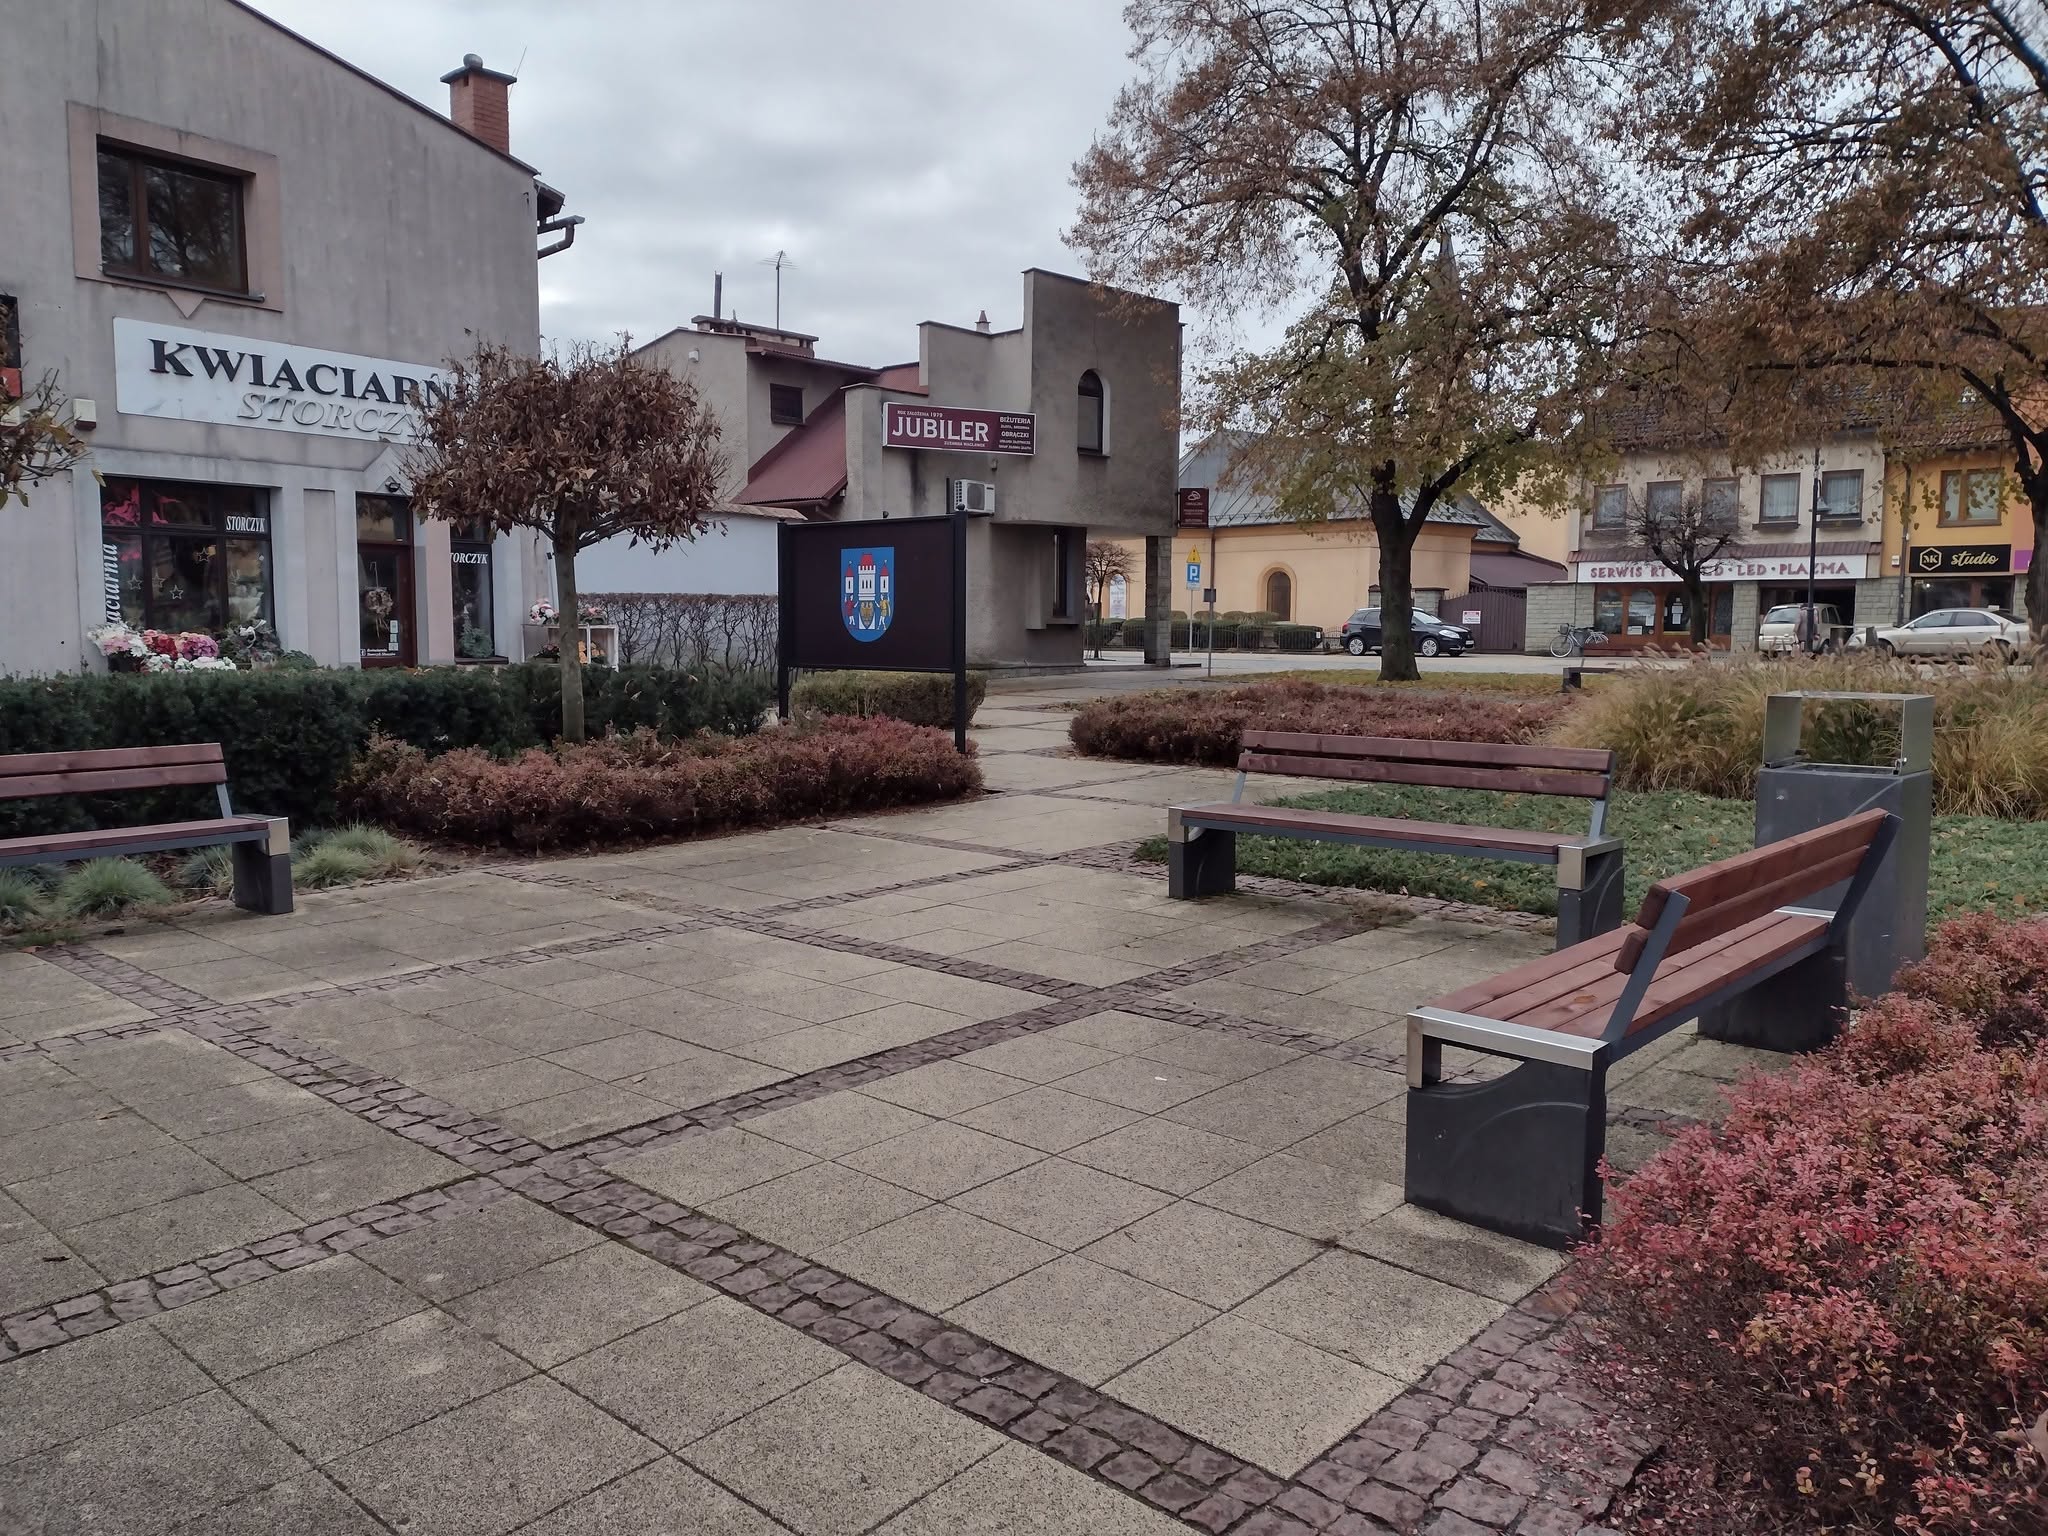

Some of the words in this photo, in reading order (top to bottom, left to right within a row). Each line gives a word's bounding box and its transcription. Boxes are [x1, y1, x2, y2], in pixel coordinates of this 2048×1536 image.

[148, 338, 453, 409] KWIACIARN
[236, 392, 419, 437] STORCZ
[892, 416, 989, 442] JUBILER
[226, 515, 265, 533] STORCZYK
[103, 543, 121, 624] aciarnia
[1590, 566, 1642, 578] SERWIS
[1737, 563, 1767, 576] LED
